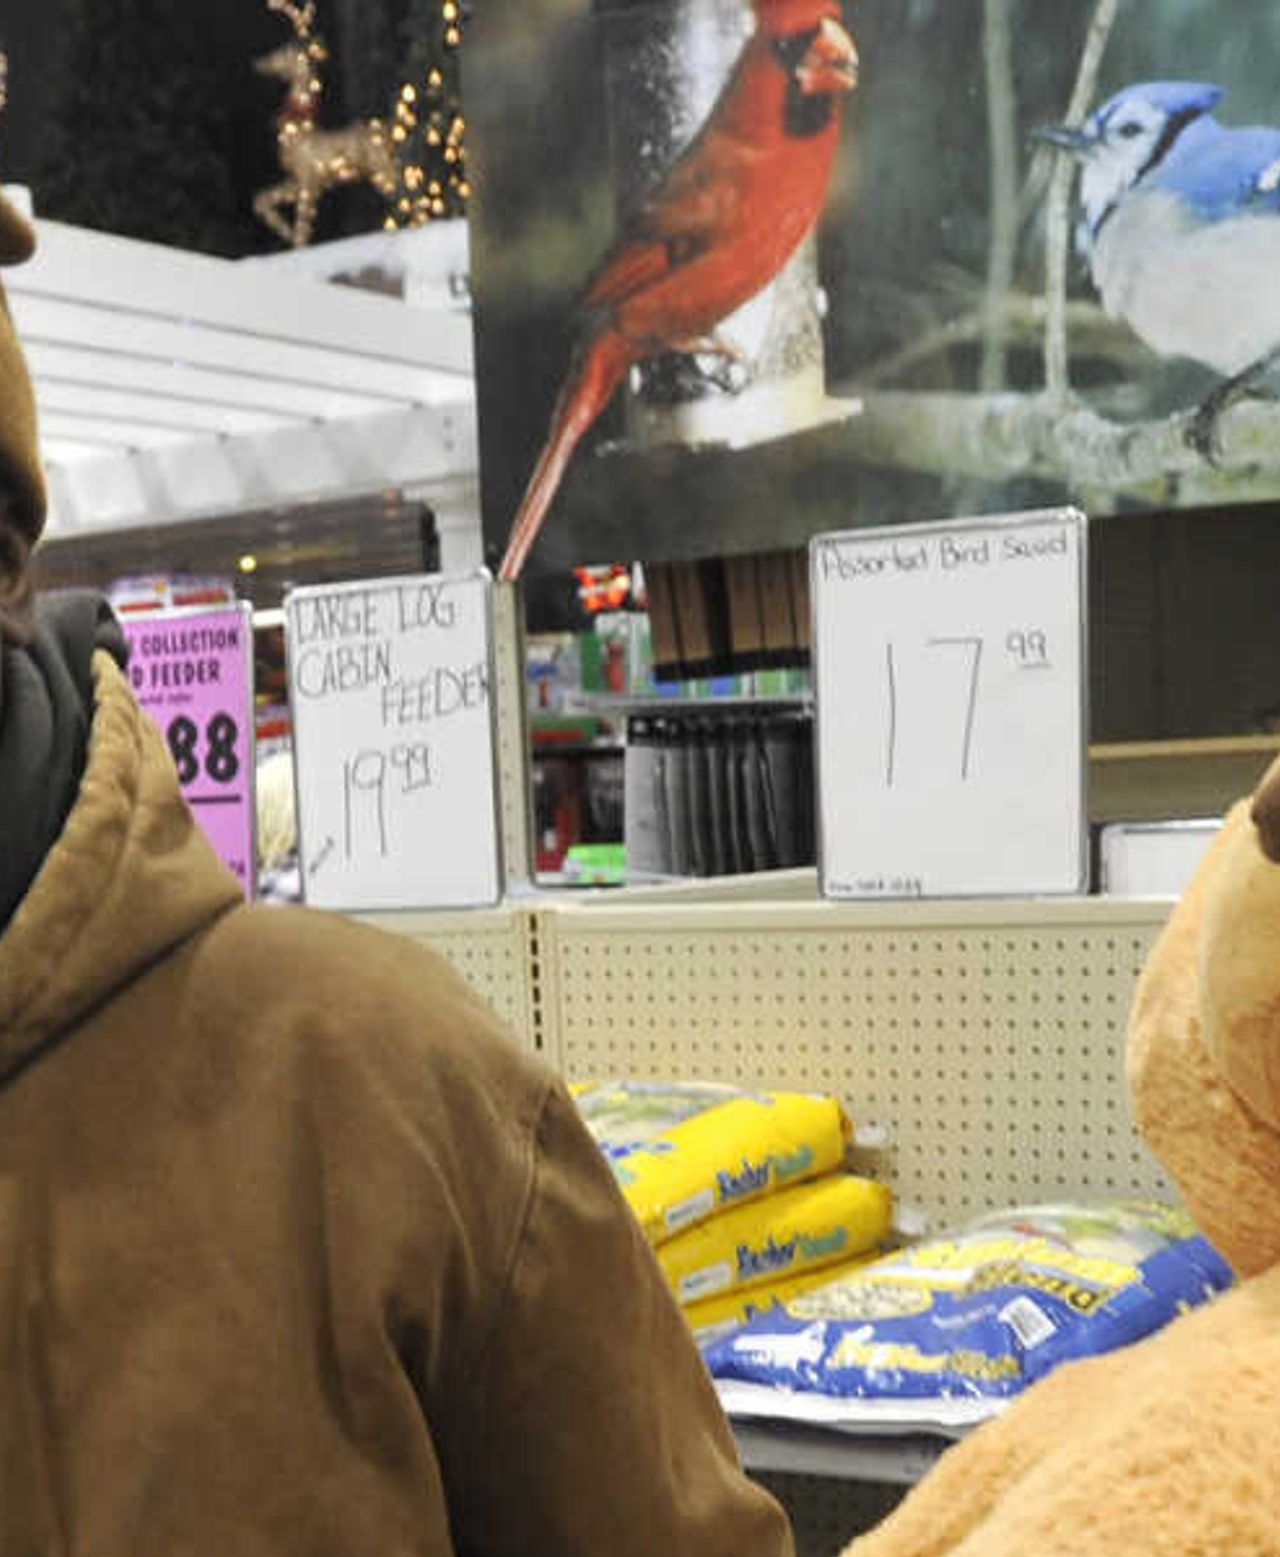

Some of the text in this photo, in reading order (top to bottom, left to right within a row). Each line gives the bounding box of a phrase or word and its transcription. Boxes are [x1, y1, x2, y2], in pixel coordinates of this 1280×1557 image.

[939, 537, 989, 571] Bird
[140, 628, 239, 657] COLLECTION
[294, 581, 455, 645] LARGE LOG
[151, 659, 220, 689] FEEDER
[296, 640, 392, 699] CABIN
[167, 711, 238, 786] 88
[344, 742, 432, 858] 19 99
